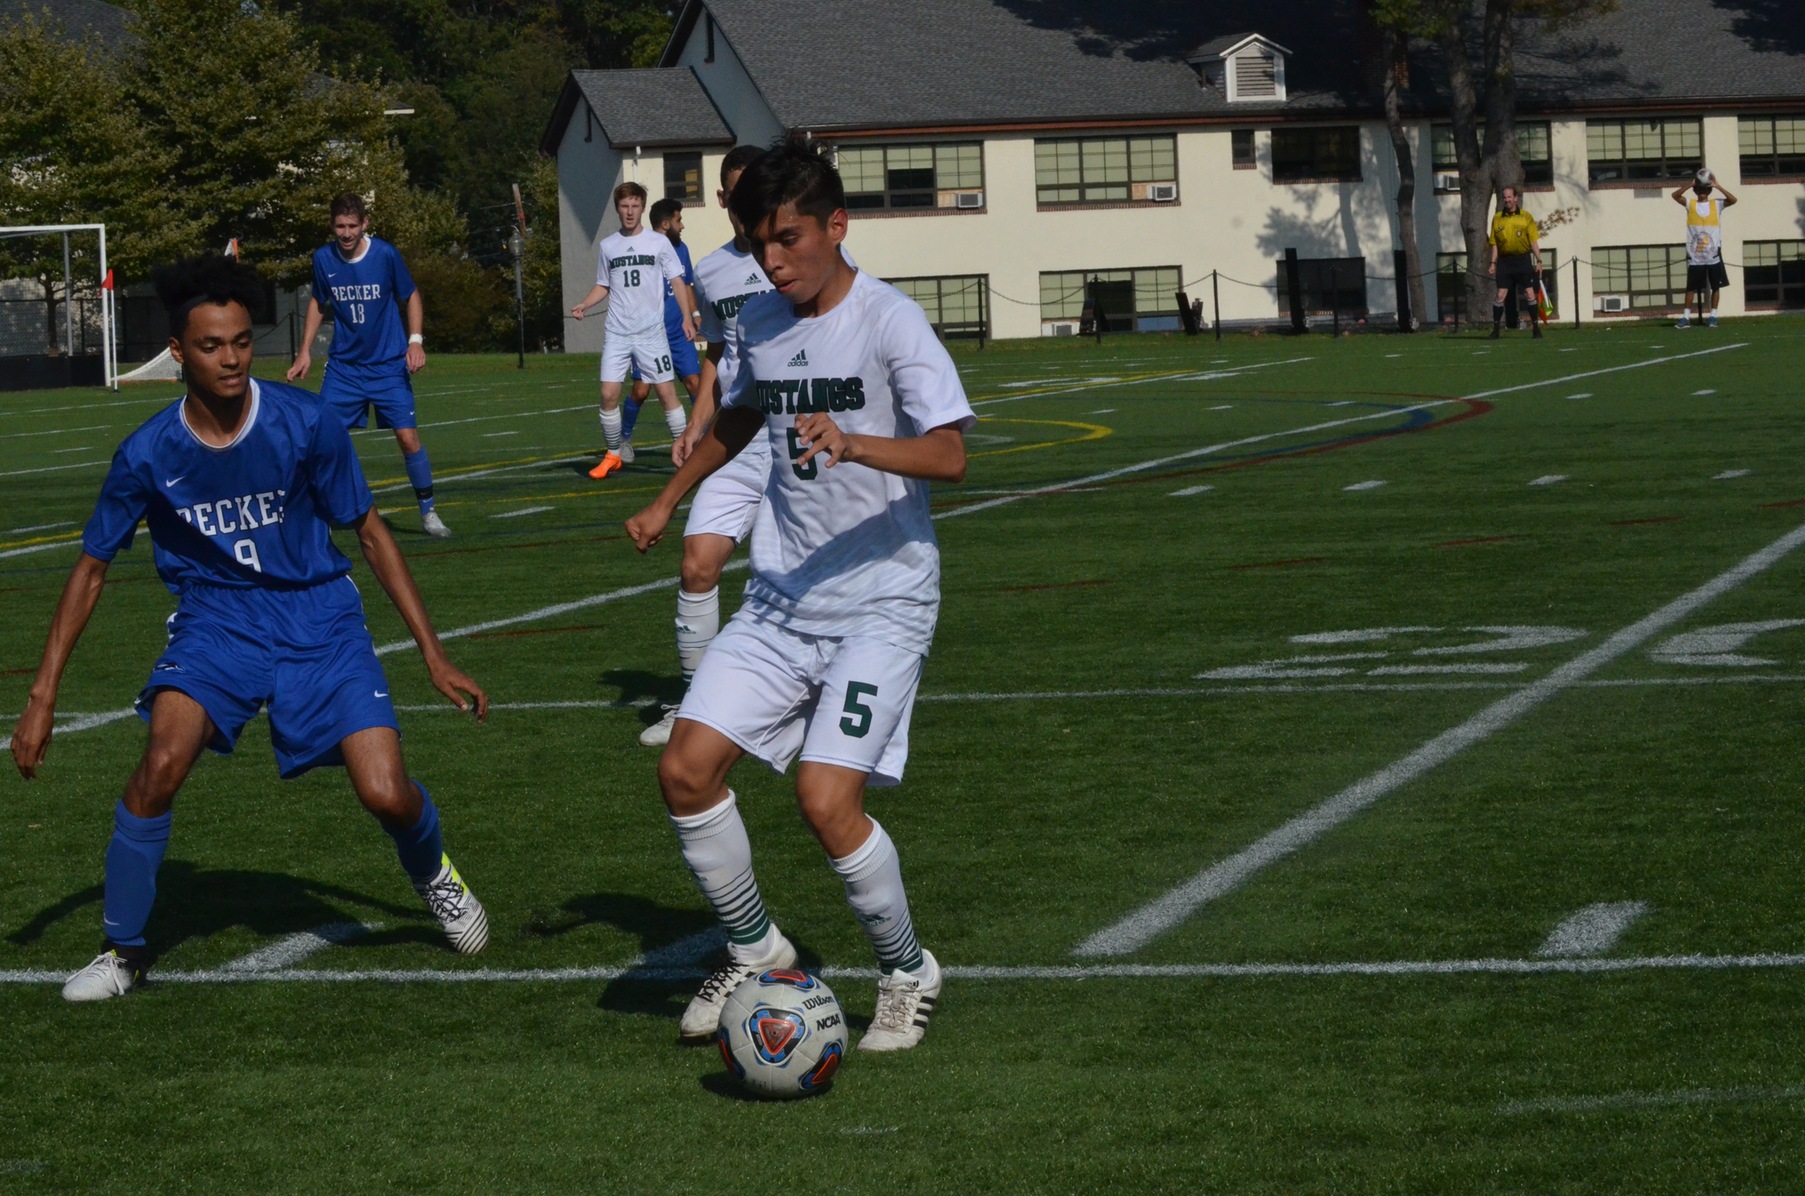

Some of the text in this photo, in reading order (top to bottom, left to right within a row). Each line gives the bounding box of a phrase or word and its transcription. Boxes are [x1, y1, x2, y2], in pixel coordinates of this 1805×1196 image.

[609, 255, 656, 269] MUSTANGS
[623, 269, 641, 287] 18
[331, 284, 381, 301] BECKER
[350, 303, 365, 324] 18
[654, 355, 672, 374] 18
[756, 376, 866, 415] USTANGS
[786, 427, 818, 480] 5
[233, 538, 262, 573] 9
[839, 681, 878, 738] 5
[802, 995, 836, 1010] Wilson
[816, 1014, 841, 1031] NCAA
